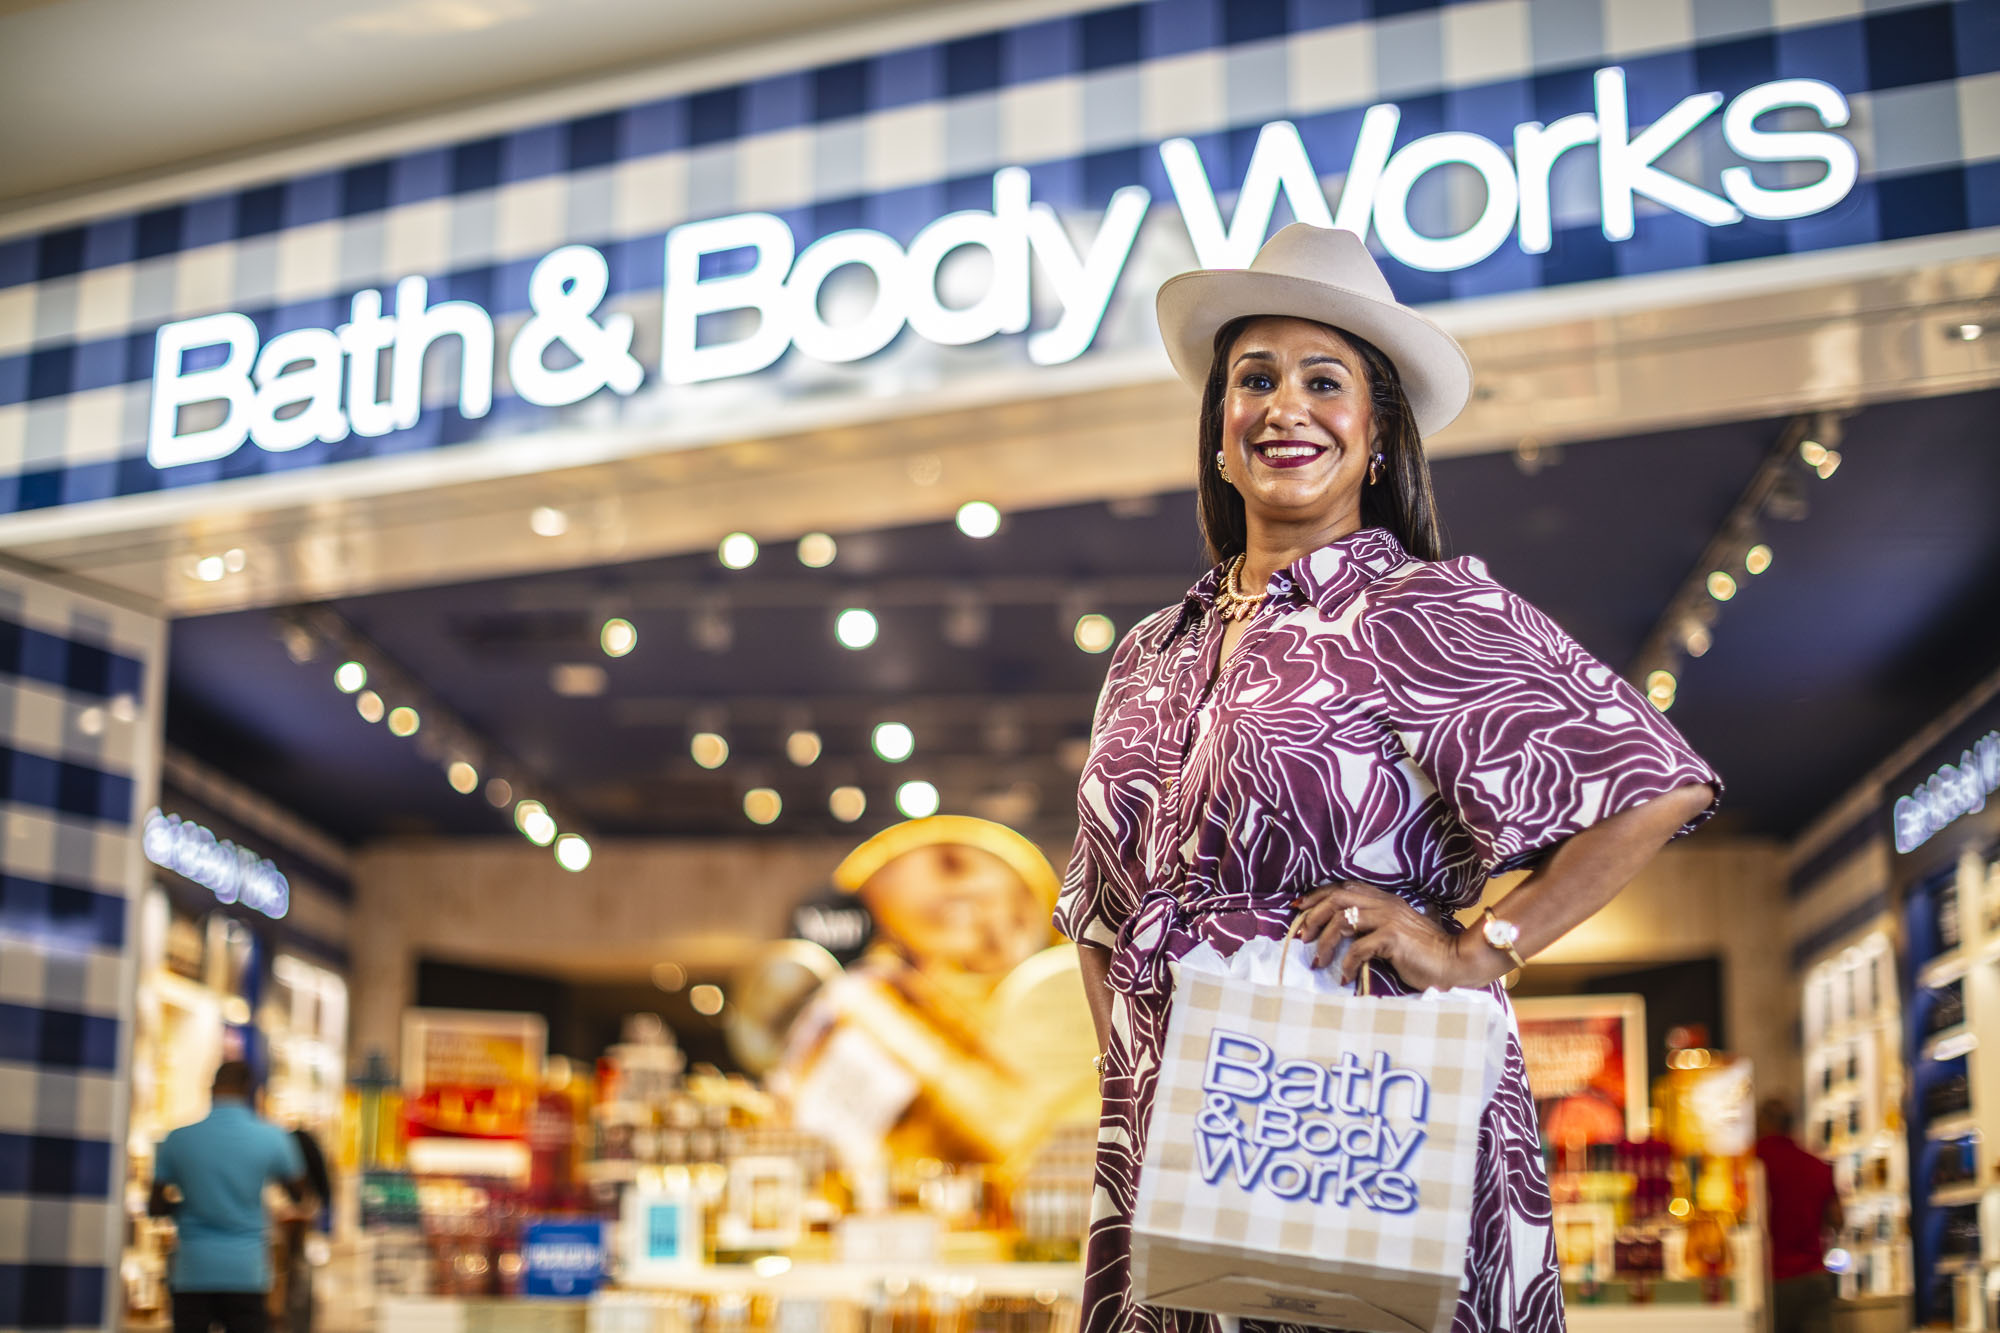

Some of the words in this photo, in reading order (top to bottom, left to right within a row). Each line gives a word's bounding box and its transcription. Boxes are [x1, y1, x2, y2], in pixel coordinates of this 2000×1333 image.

[147, 275, 494, 469] Bath
[509, 245, 644, 406] &
[662, 166, 1151, 385] Body
[1159, 67, 1859, 271] Works
[1202, 1028, 1429, 1121] Bath
[1194, 1129, 1418, 1215] Works
[1196, 1092, 1247, 1139] &
[1253, 1103, 1426, 1171] Body
